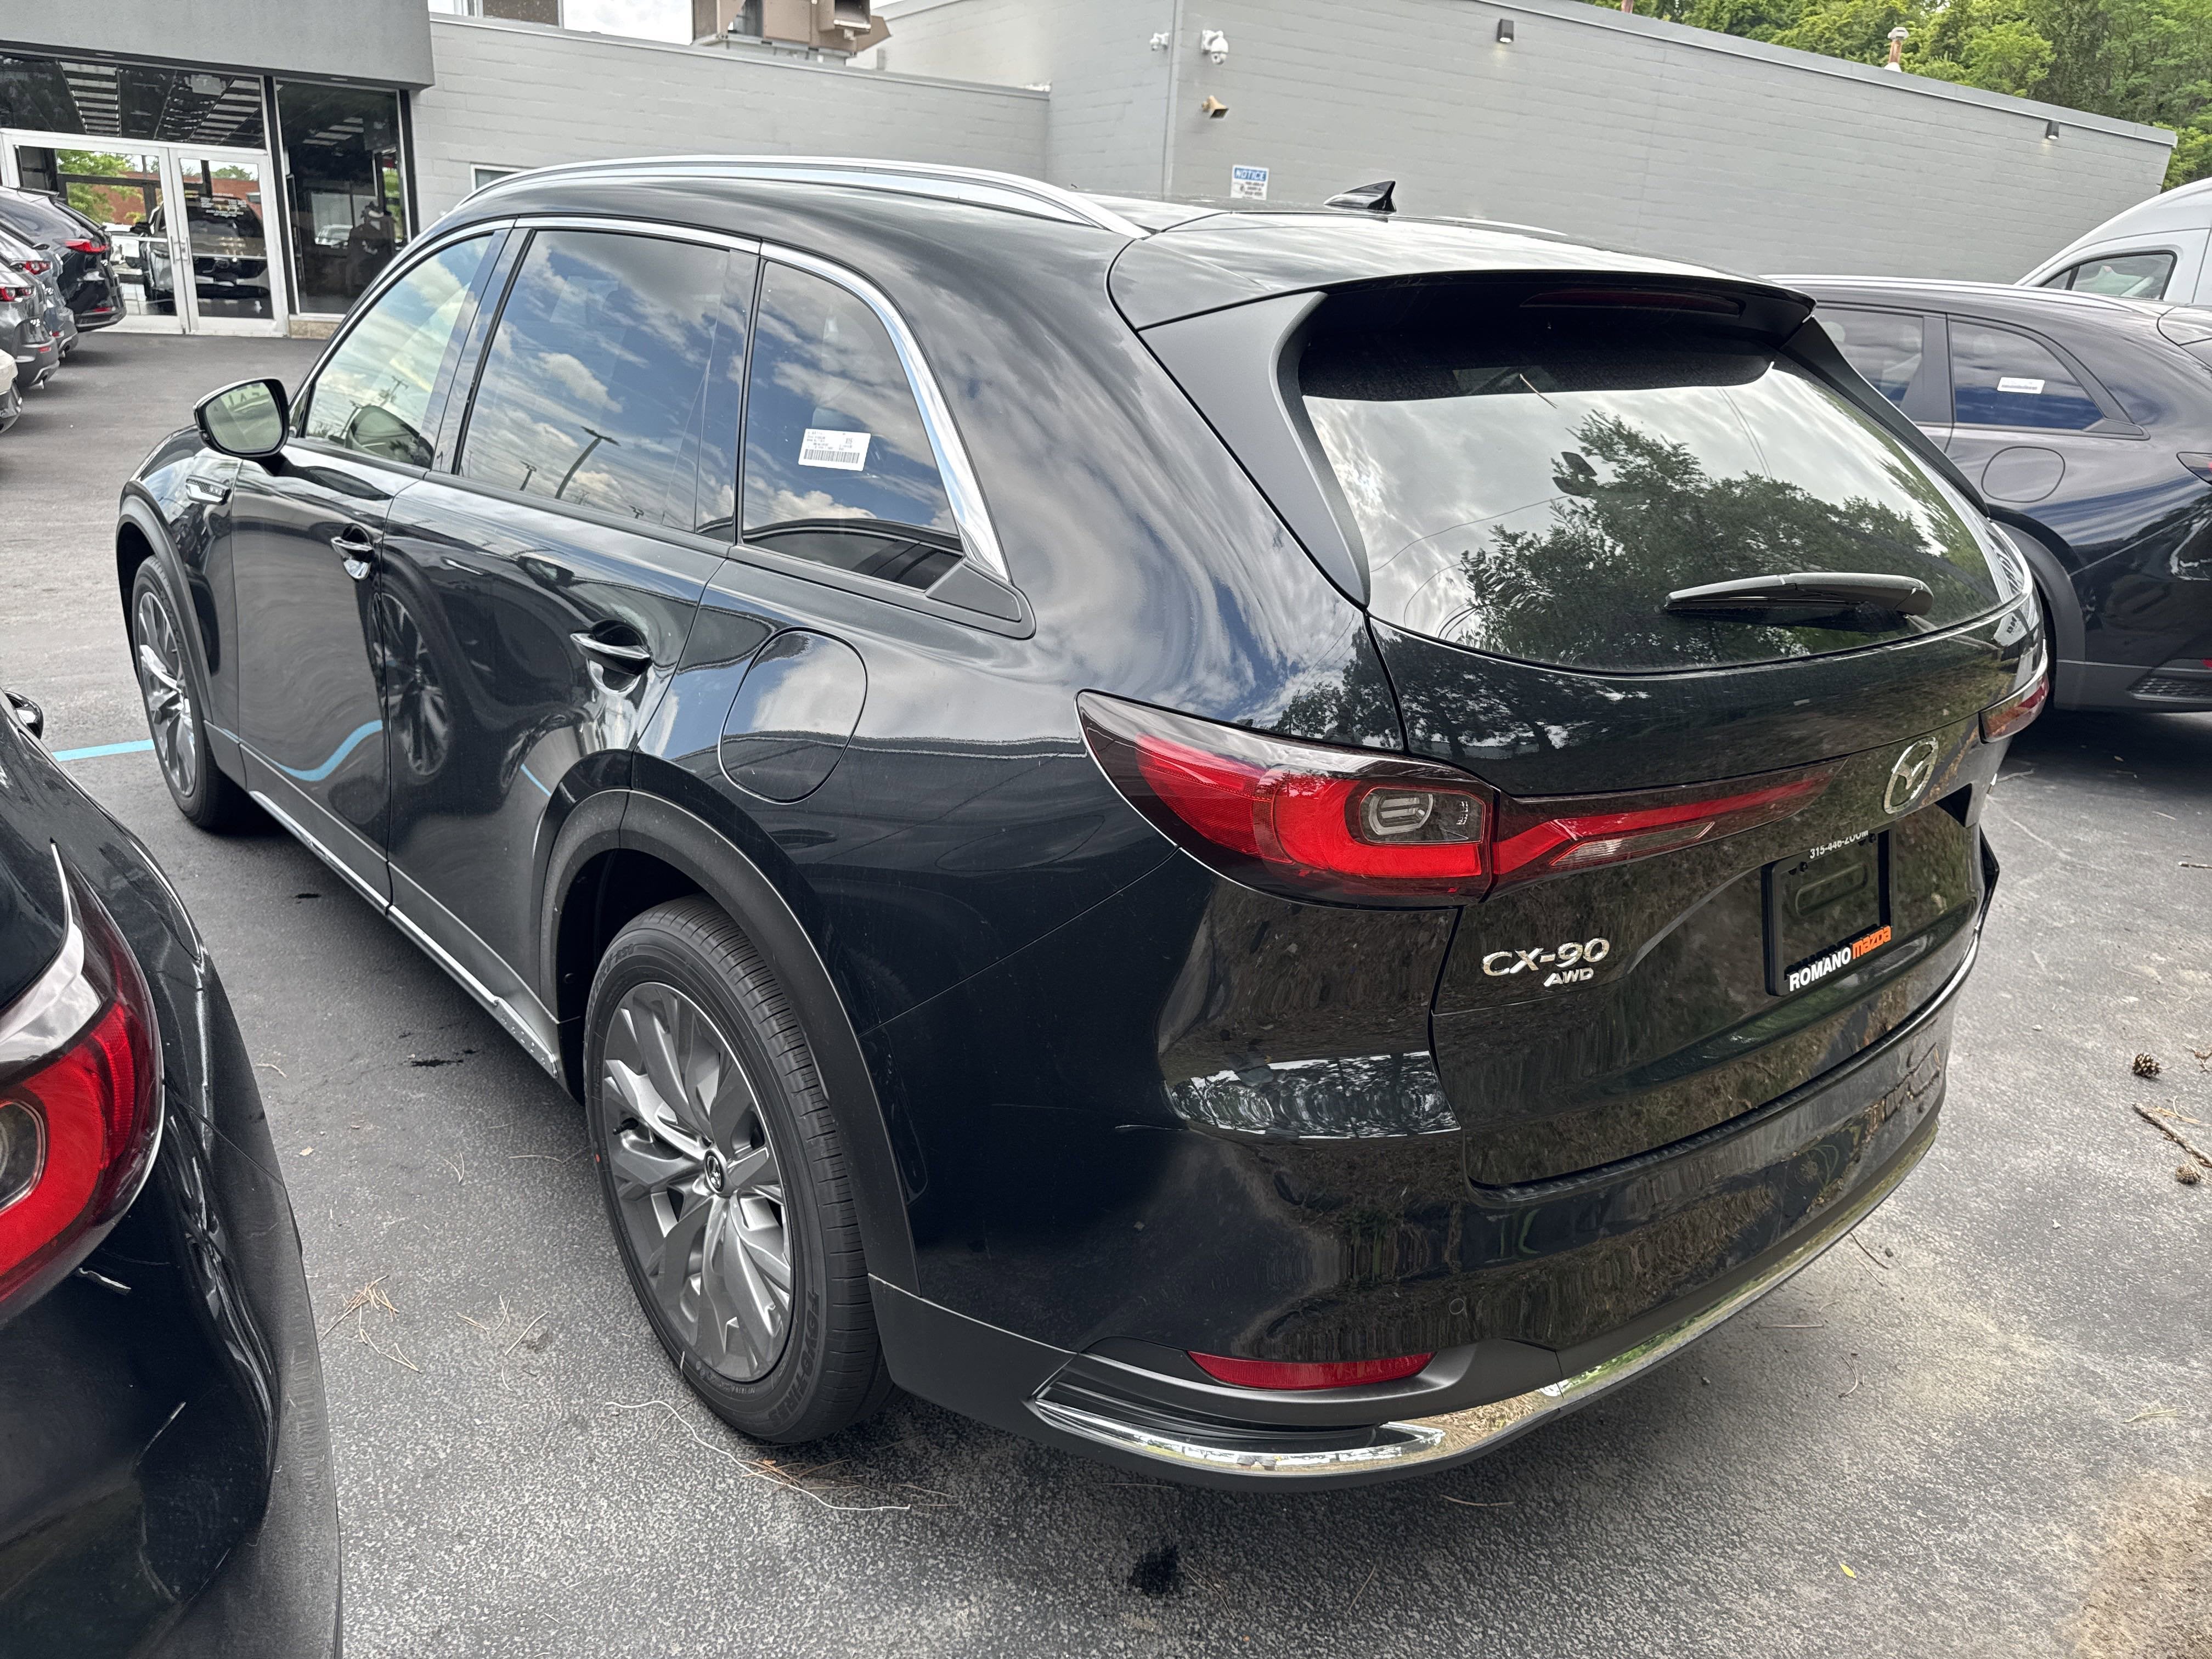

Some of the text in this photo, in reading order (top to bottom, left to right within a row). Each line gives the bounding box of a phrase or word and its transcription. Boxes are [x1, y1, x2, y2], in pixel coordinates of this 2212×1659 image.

[1236, 170, 1265, 180] NOTICE
[1482, 937, 1610, 977] CX-90
[1543, 966, 1594, 987] AWD
[1788, 947, 1852, 992] ROMANO
[769, 1290, 820, 1427] TOYO TIRES
